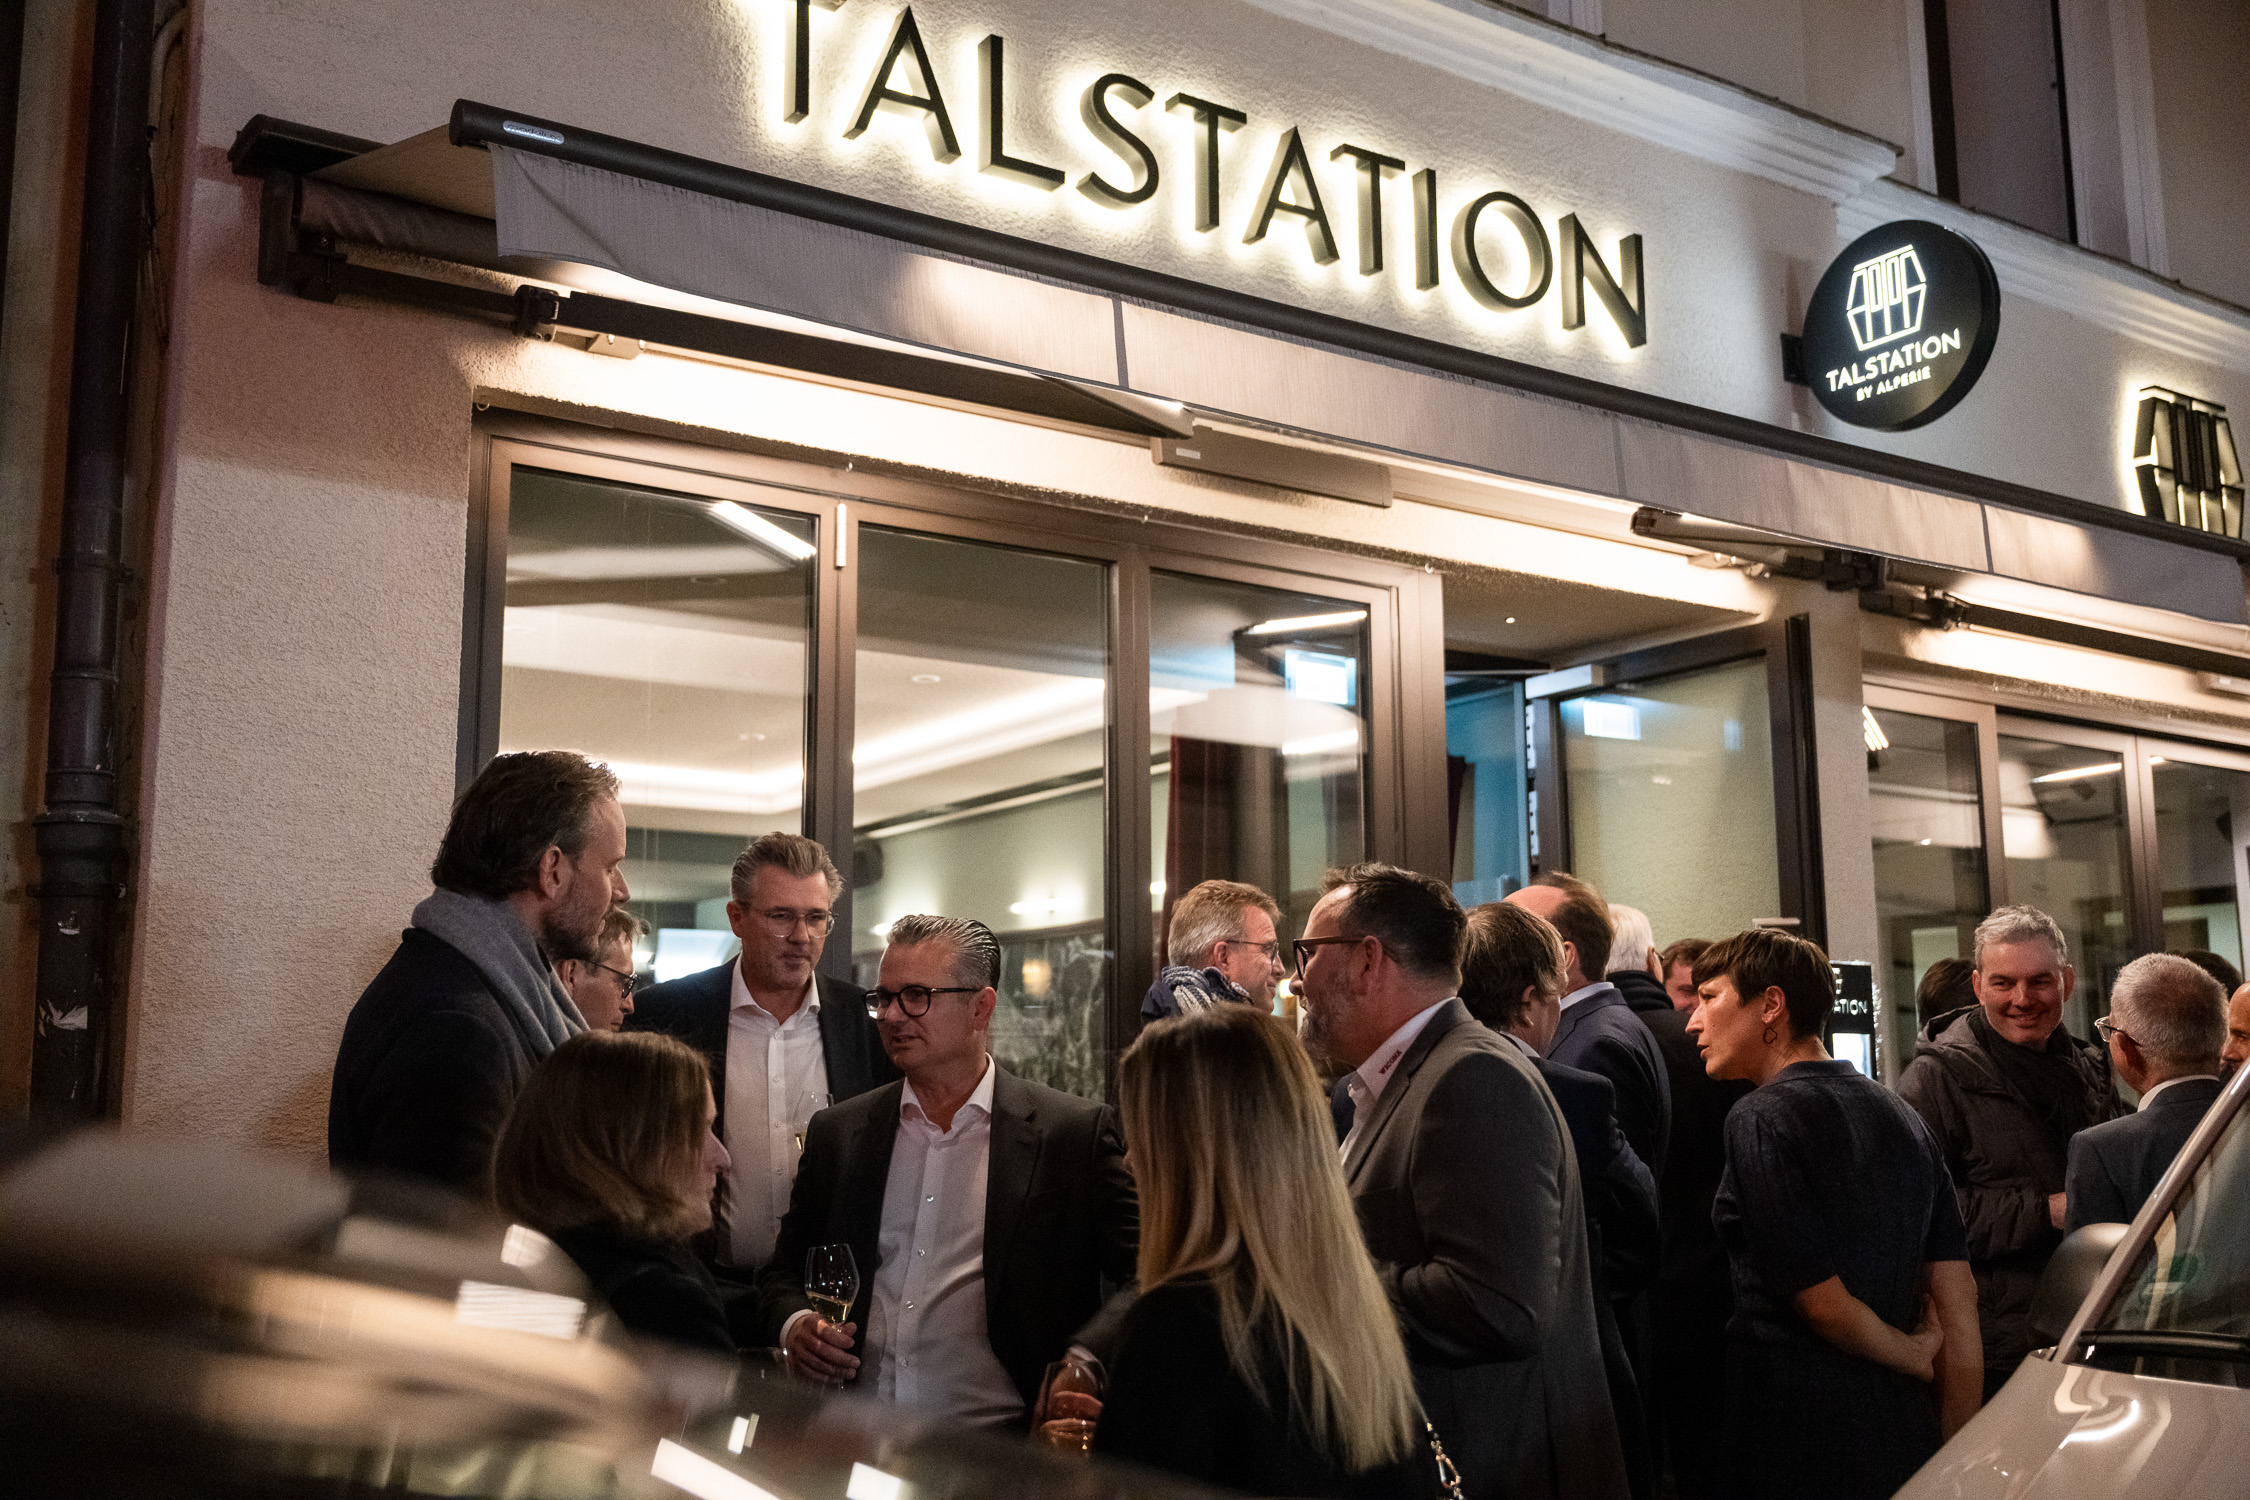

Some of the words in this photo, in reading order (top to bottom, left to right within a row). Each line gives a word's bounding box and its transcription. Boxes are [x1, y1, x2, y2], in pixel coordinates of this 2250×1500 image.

[783, 0, 1646, 348] TALSTATION
[1826, 328, 1961, 392] TALSTATION
[1857, 385, 1873, 402] BY
[1833, 998, 1868, 1015] ATION
